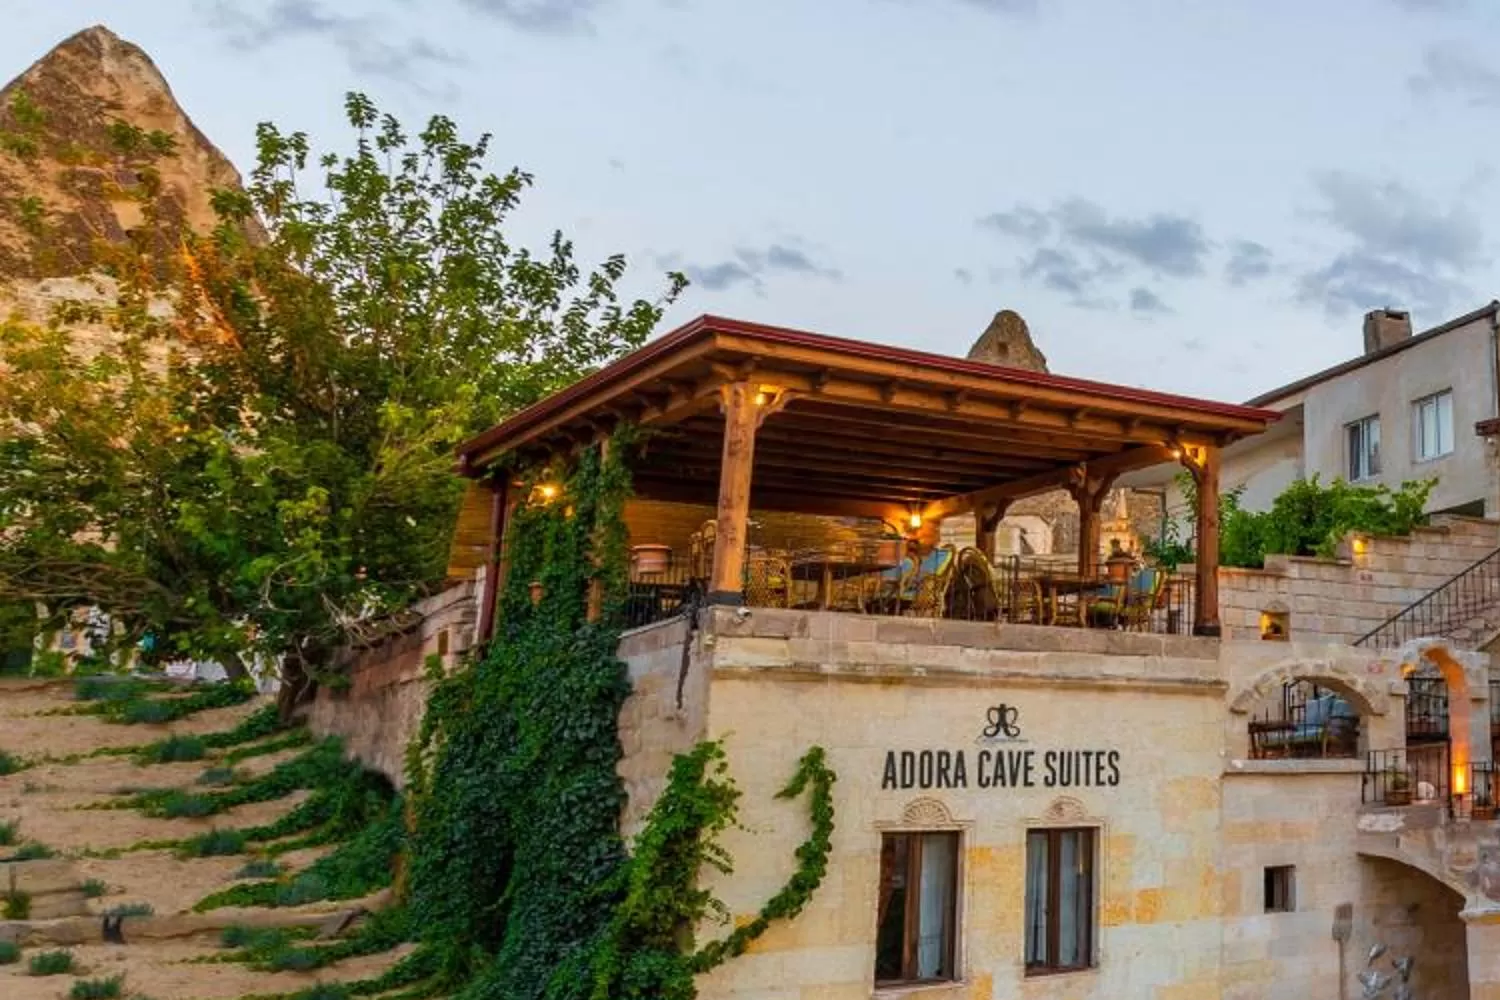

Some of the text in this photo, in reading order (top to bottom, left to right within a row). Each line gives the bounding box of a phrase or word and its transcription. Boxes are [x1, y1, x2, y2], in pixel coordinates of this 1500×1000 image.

[881, 749, 1121, 790] ADORA CAVE SUITES
